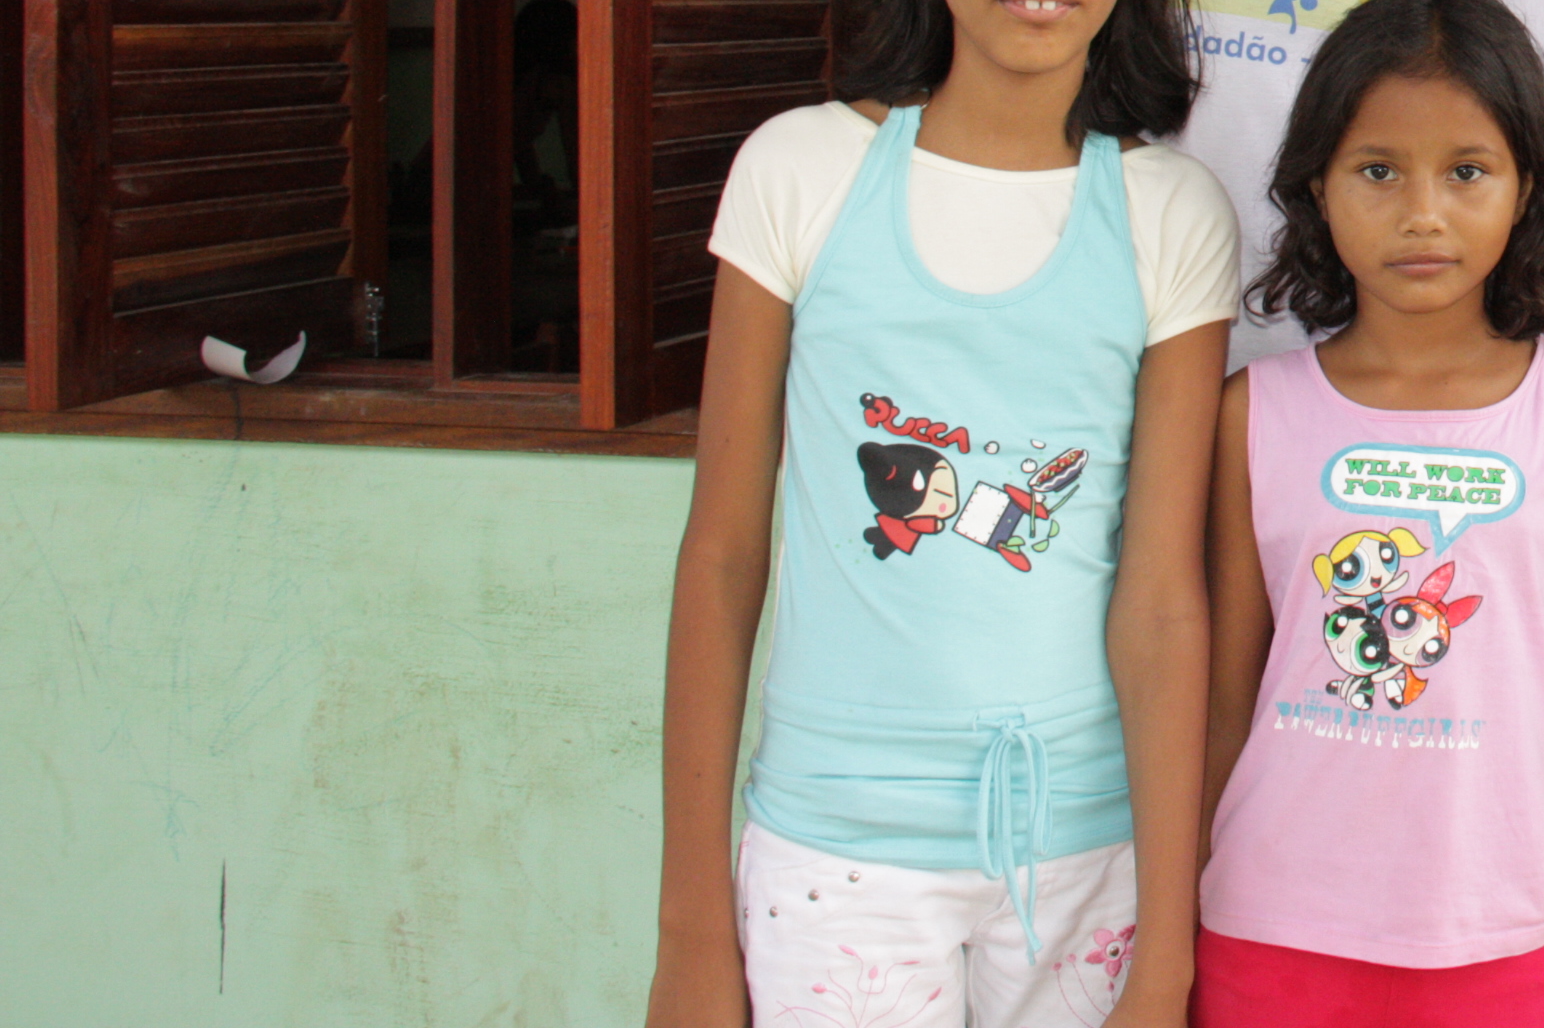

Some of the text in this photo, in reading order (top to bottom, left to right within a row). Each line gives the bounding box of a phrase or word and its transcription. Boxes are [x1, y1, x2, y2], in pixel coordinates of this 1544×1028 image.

[1185, 25, 1288, 65] dadão
[1345, 458, 1506, 484] WILL WORK
[1343, 478, 1502, 504] FOR PEACE
